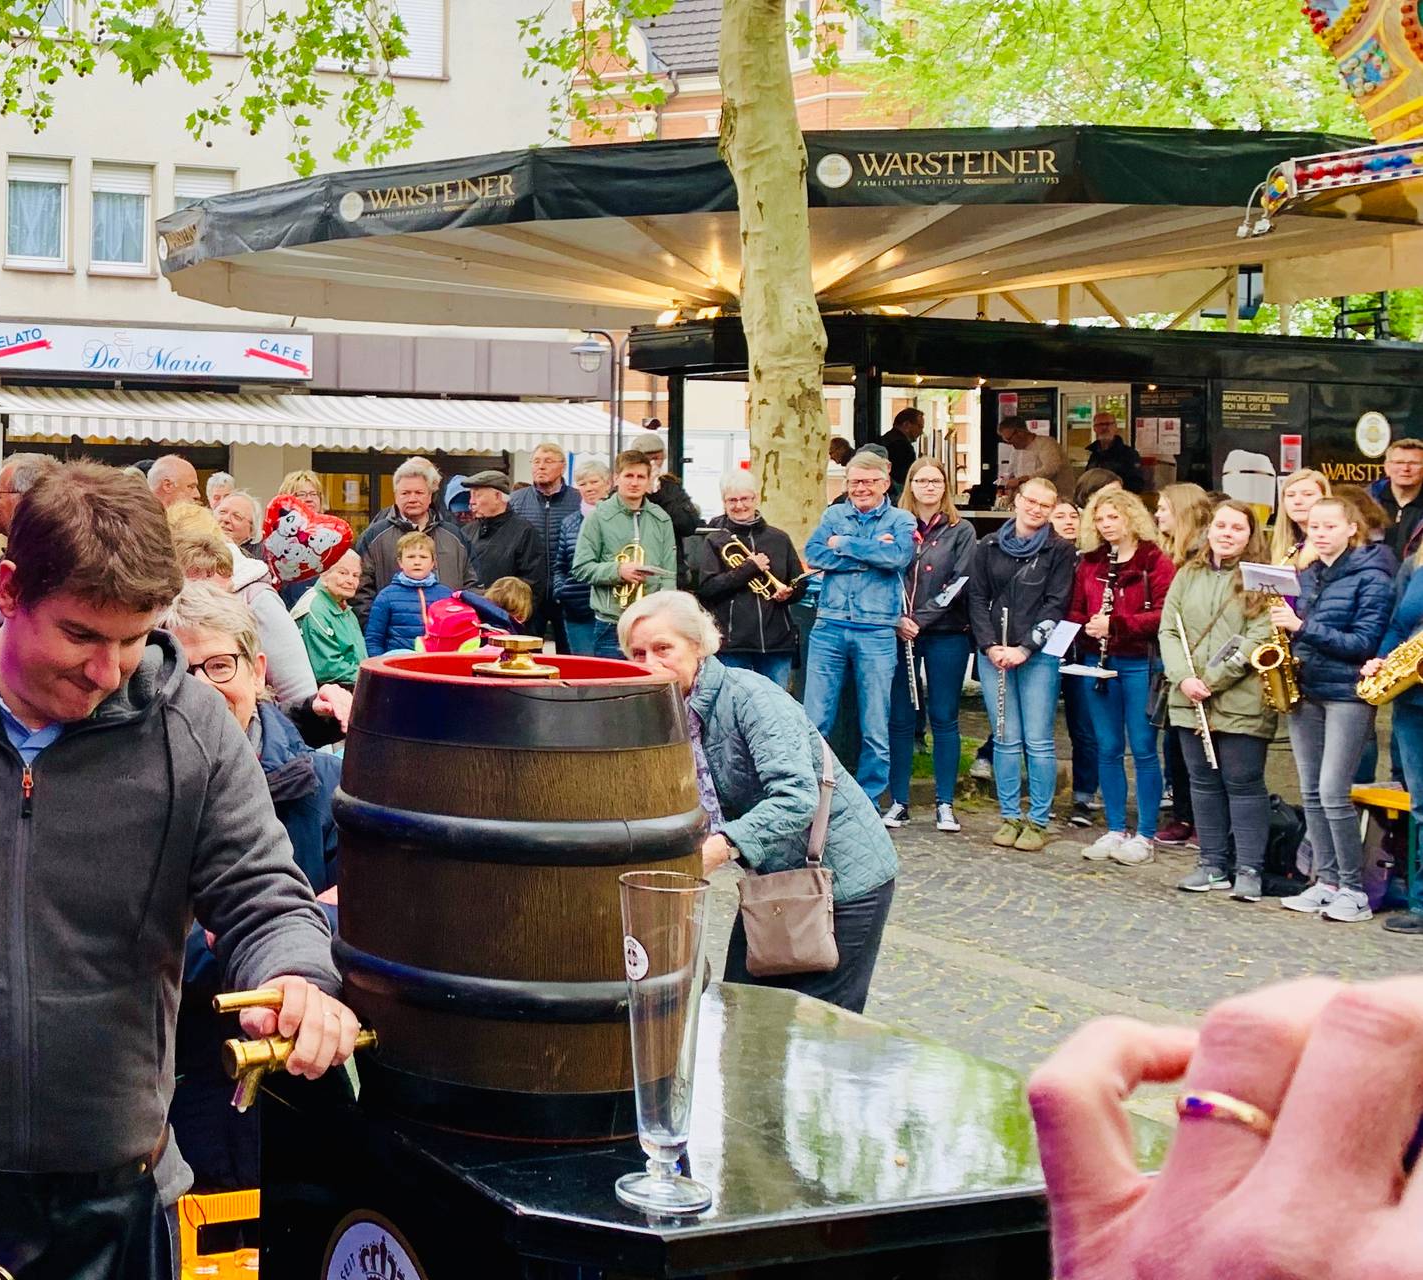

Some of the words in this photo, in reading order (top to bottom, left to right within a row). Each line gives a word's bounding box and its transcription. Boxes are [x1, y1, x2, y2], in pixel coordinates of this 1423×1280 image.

[857, 149, 1059, 177] WARSTEINER
[367, 174, 515, 210] WARSTEINER
[857, 178, 961, 187] FAMILIENTRADITION
[1041, 177, 1060, 185] 1753
[82, 338, 121, 369] Da
[134, 346, 216, 372] Maria
[260, 338, 303, 362] CAFE
